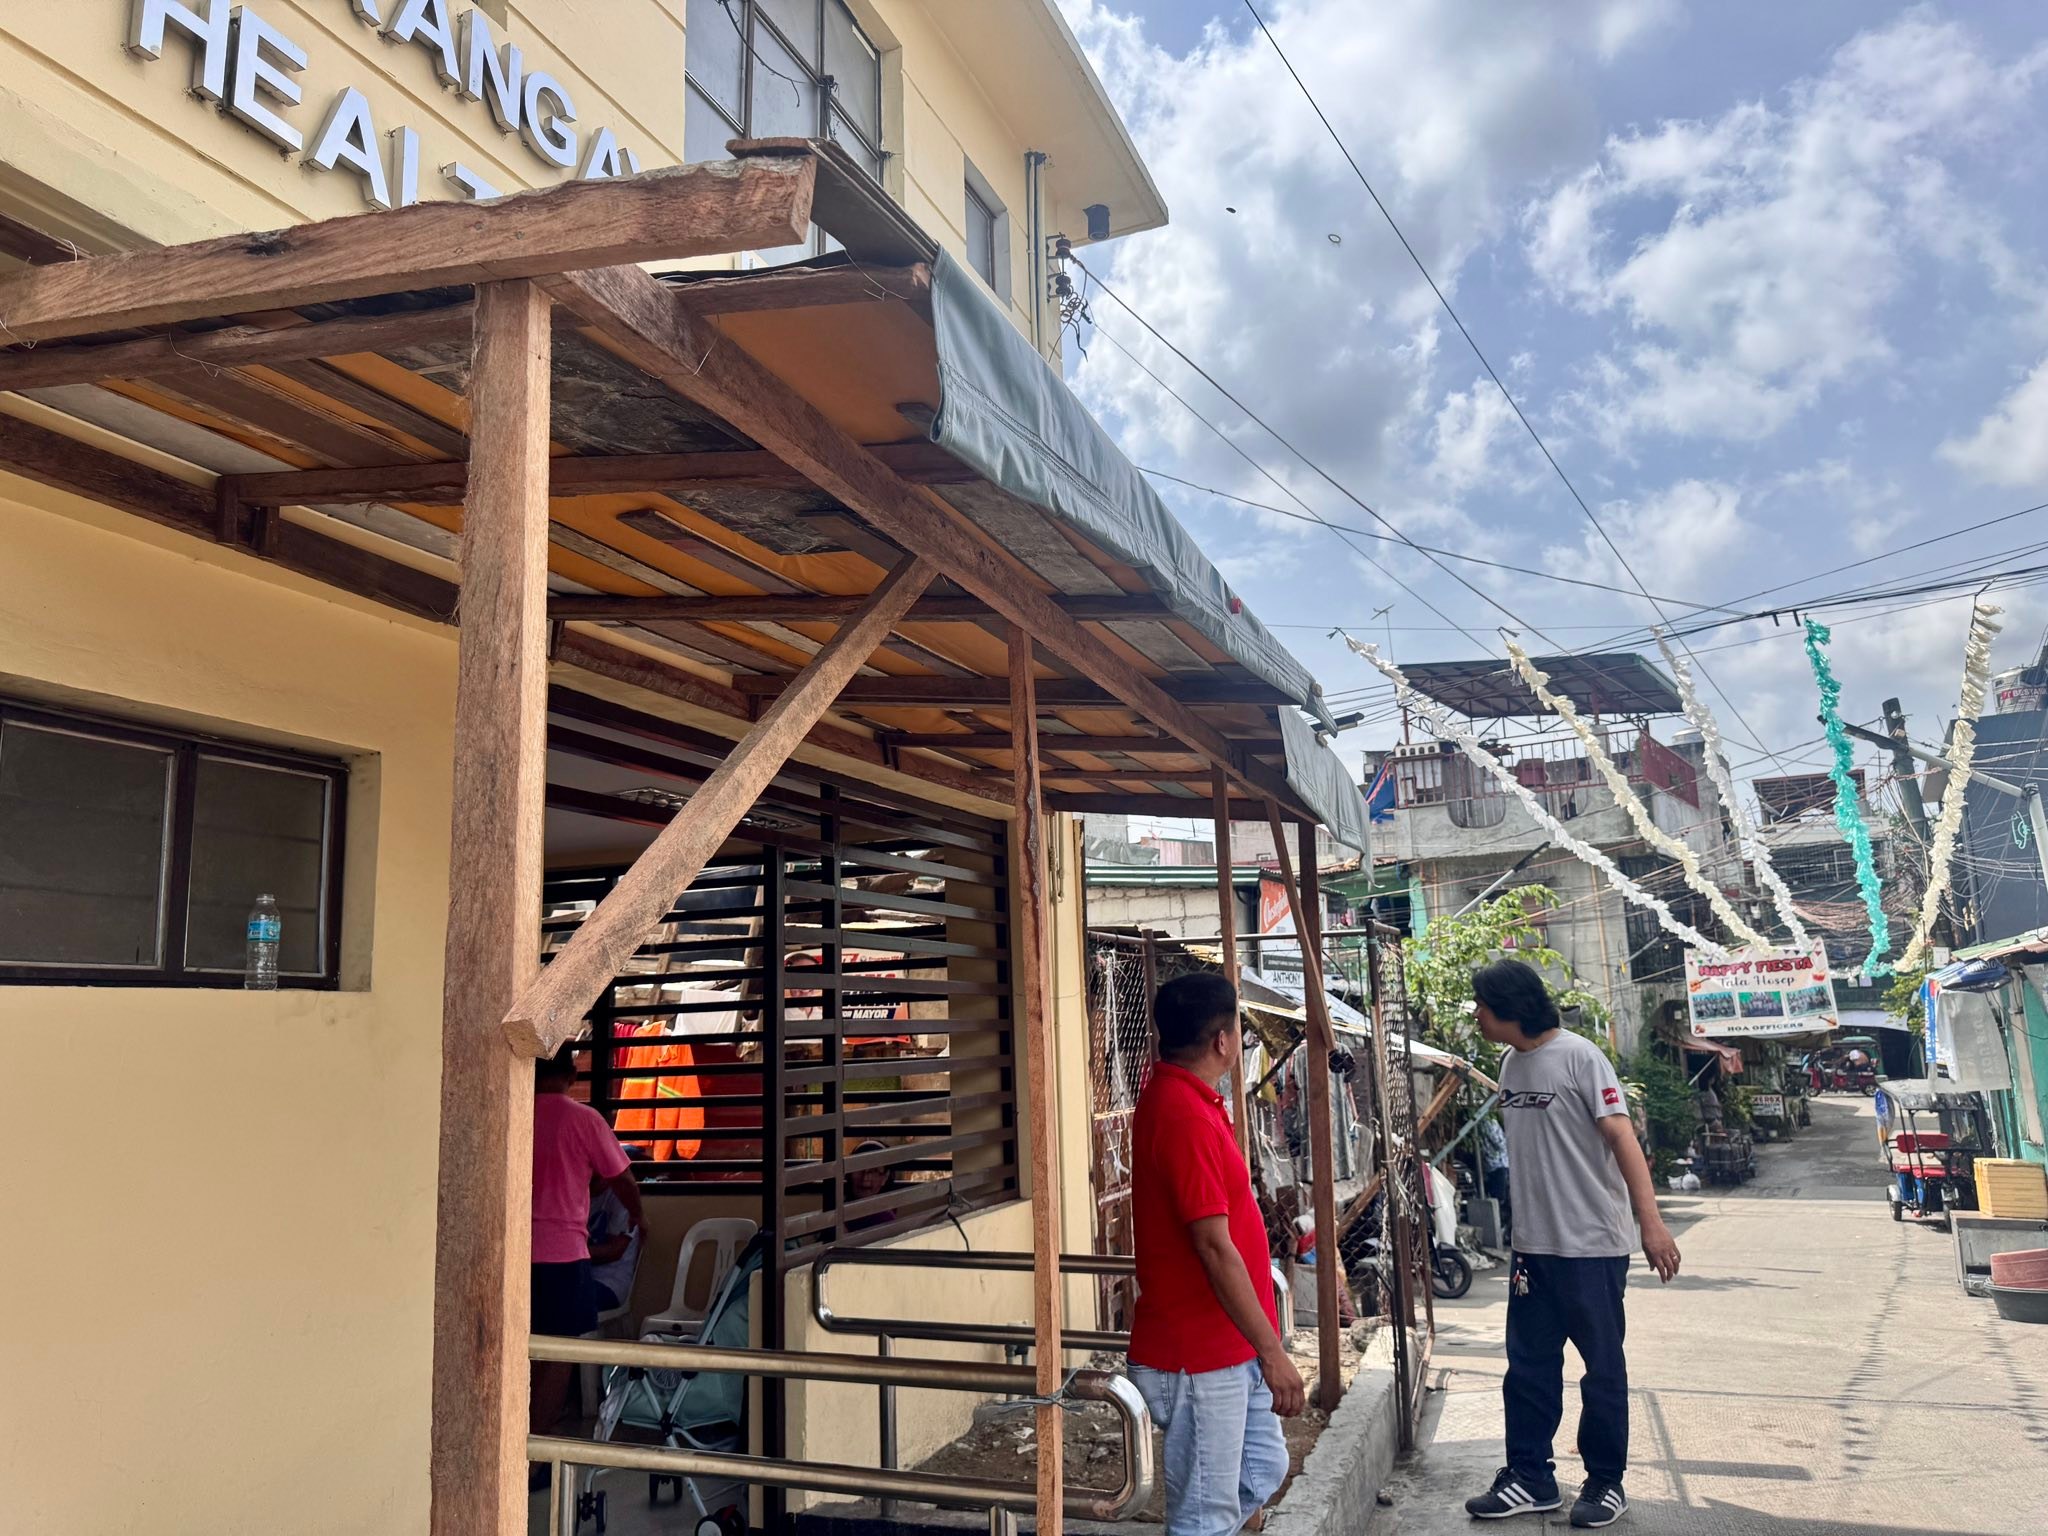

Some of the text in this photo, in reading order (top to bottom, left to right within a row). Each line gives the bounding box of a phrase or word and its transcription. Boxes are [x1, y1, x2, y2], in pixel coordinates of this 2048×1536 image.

[1699, 957, 1813, 976] HAPPY FIESTA
[1273, 972, 1301, 984] ANTHONY
[853, 1010, 888, 1018] MAYOR
